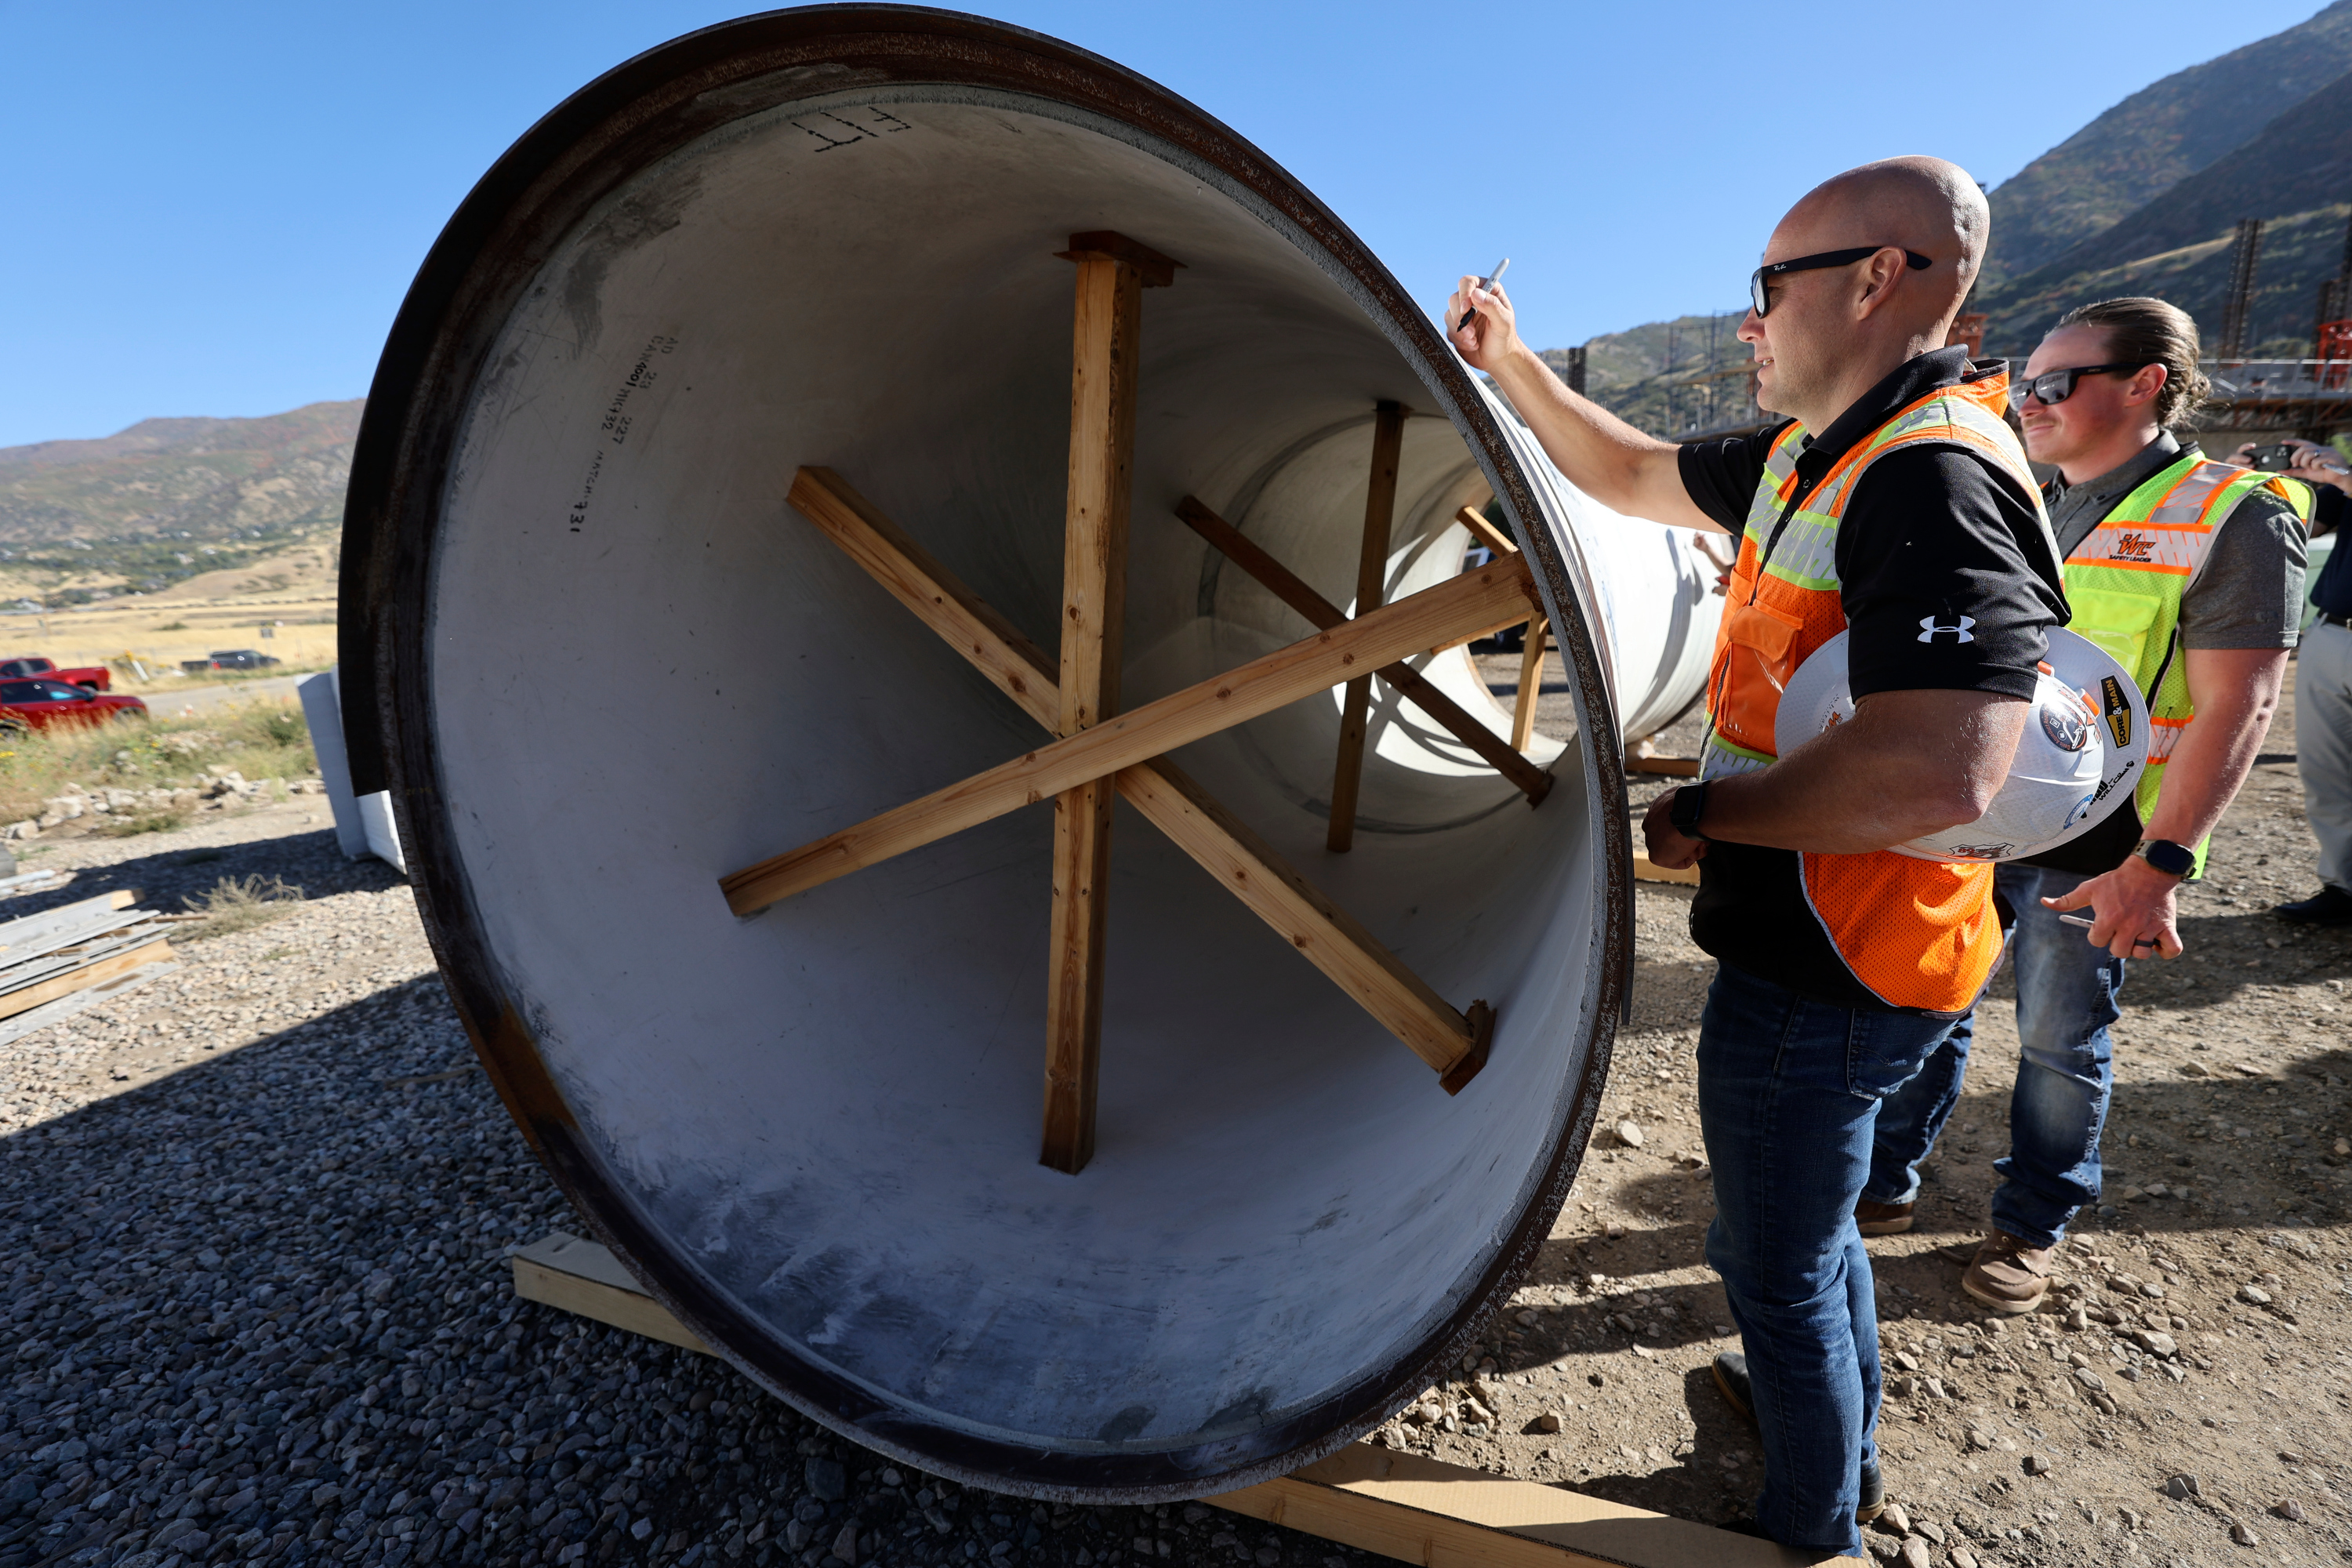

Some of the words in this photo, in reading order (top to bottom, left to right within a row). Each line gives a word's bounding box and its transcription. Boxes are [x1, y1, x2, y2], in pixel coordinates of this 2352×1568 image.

[2105, 679, 2122, 707] MAIN
[2112, 706, 2124, 716] &
[2116, 714, 2127, 744] CORE
